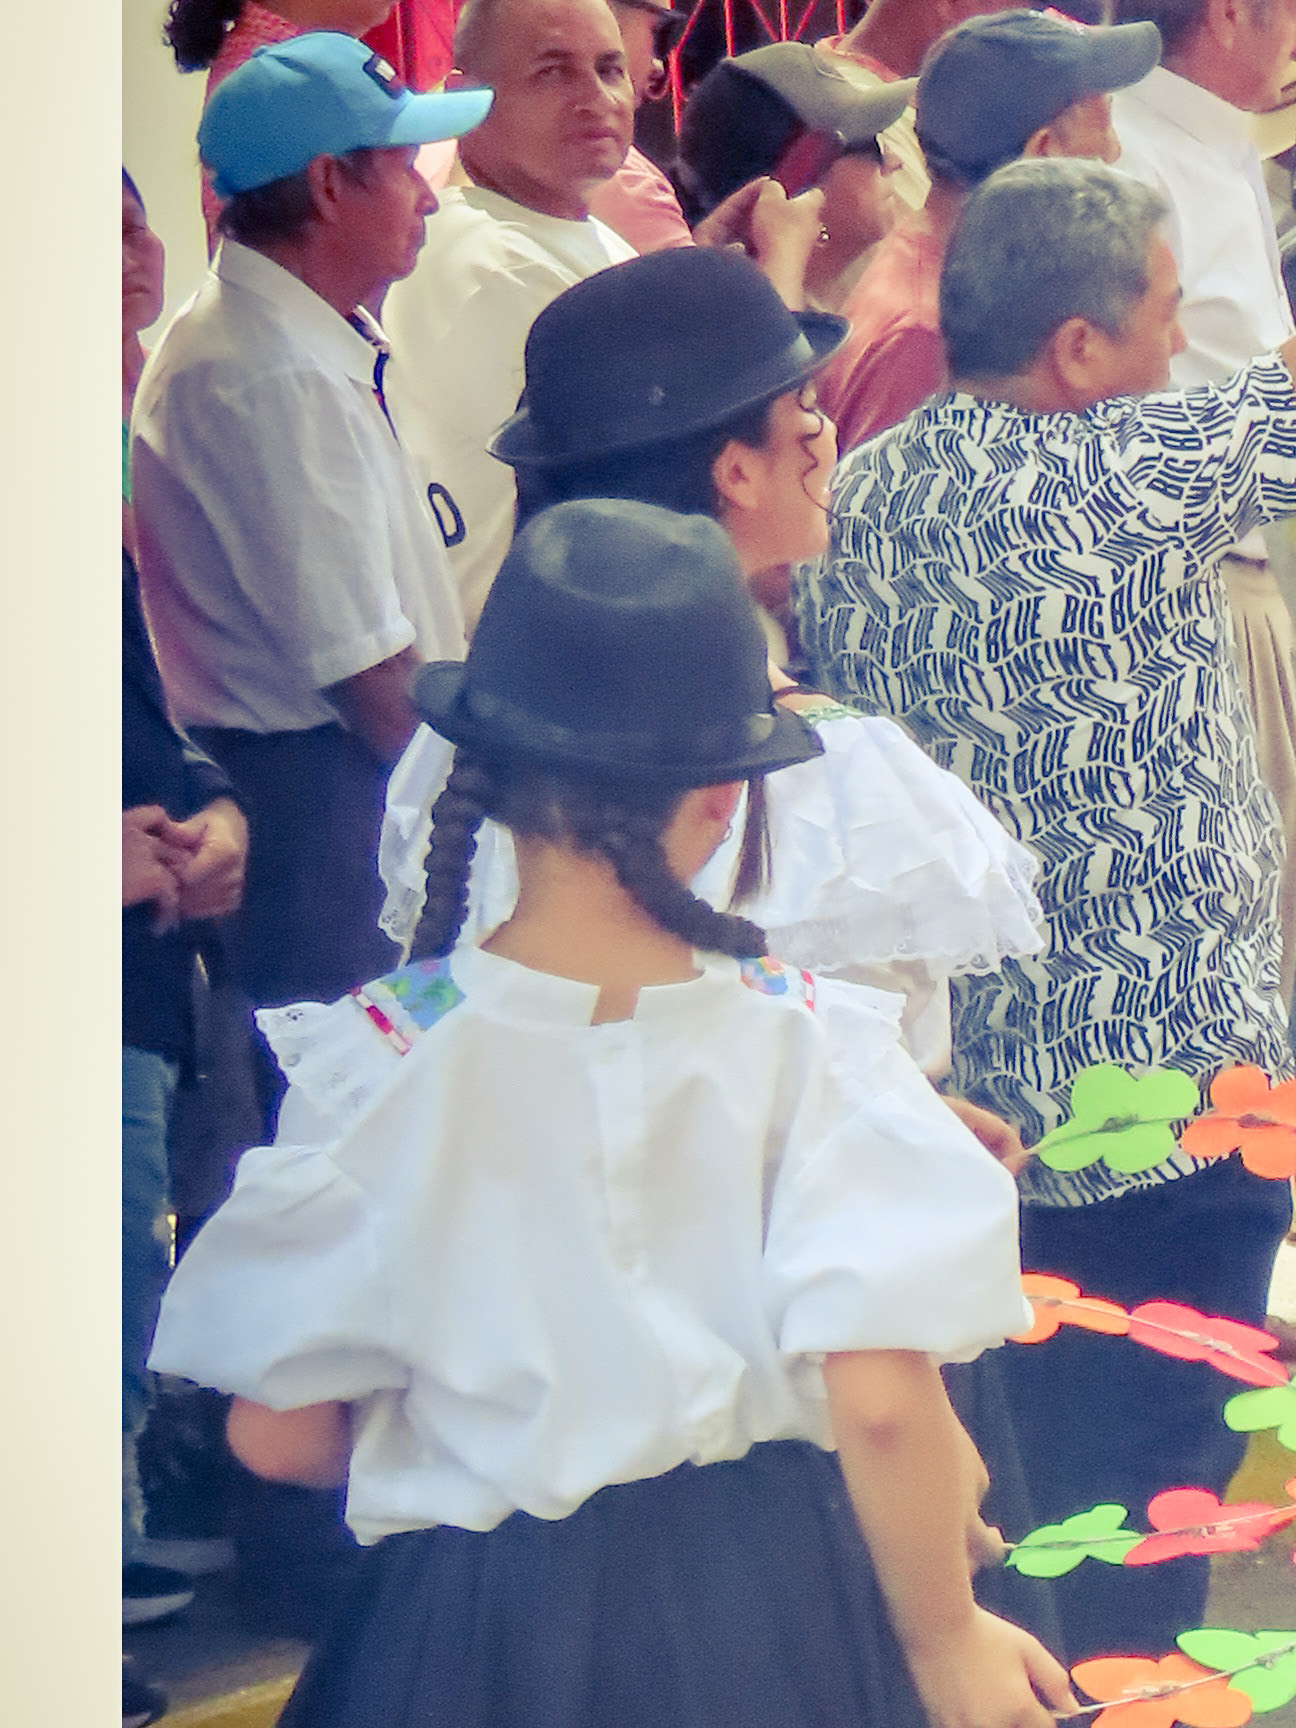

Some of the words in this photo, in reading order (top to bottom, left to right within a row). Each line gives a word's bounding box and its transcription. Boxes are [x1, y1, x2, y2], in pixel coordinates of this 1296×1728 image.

[1028, 470, 1064, 511] BIG
[1018, 504, 1084, 556] WET
[985, 594, 1047, 664] BLUE
[1060, 592, 1106, 640] BIG
[1110, 547, 1172, 635] BLUE
[1053, 635, 1118, 684] WET
[970, 742, 1010, 795] BIG
[1013, 724, 1076, 795] BLUE
[1086, 721, 1127, 769] BIG
[1131, 671, 1187, 763] BLUE
[1078, 765, 1136, 811] WET
[1042, 974, 1102, 1045] BLUE
[1111, 972, 1150, 1023] BIG
[1103, 1017, 1153, 1067] WET
